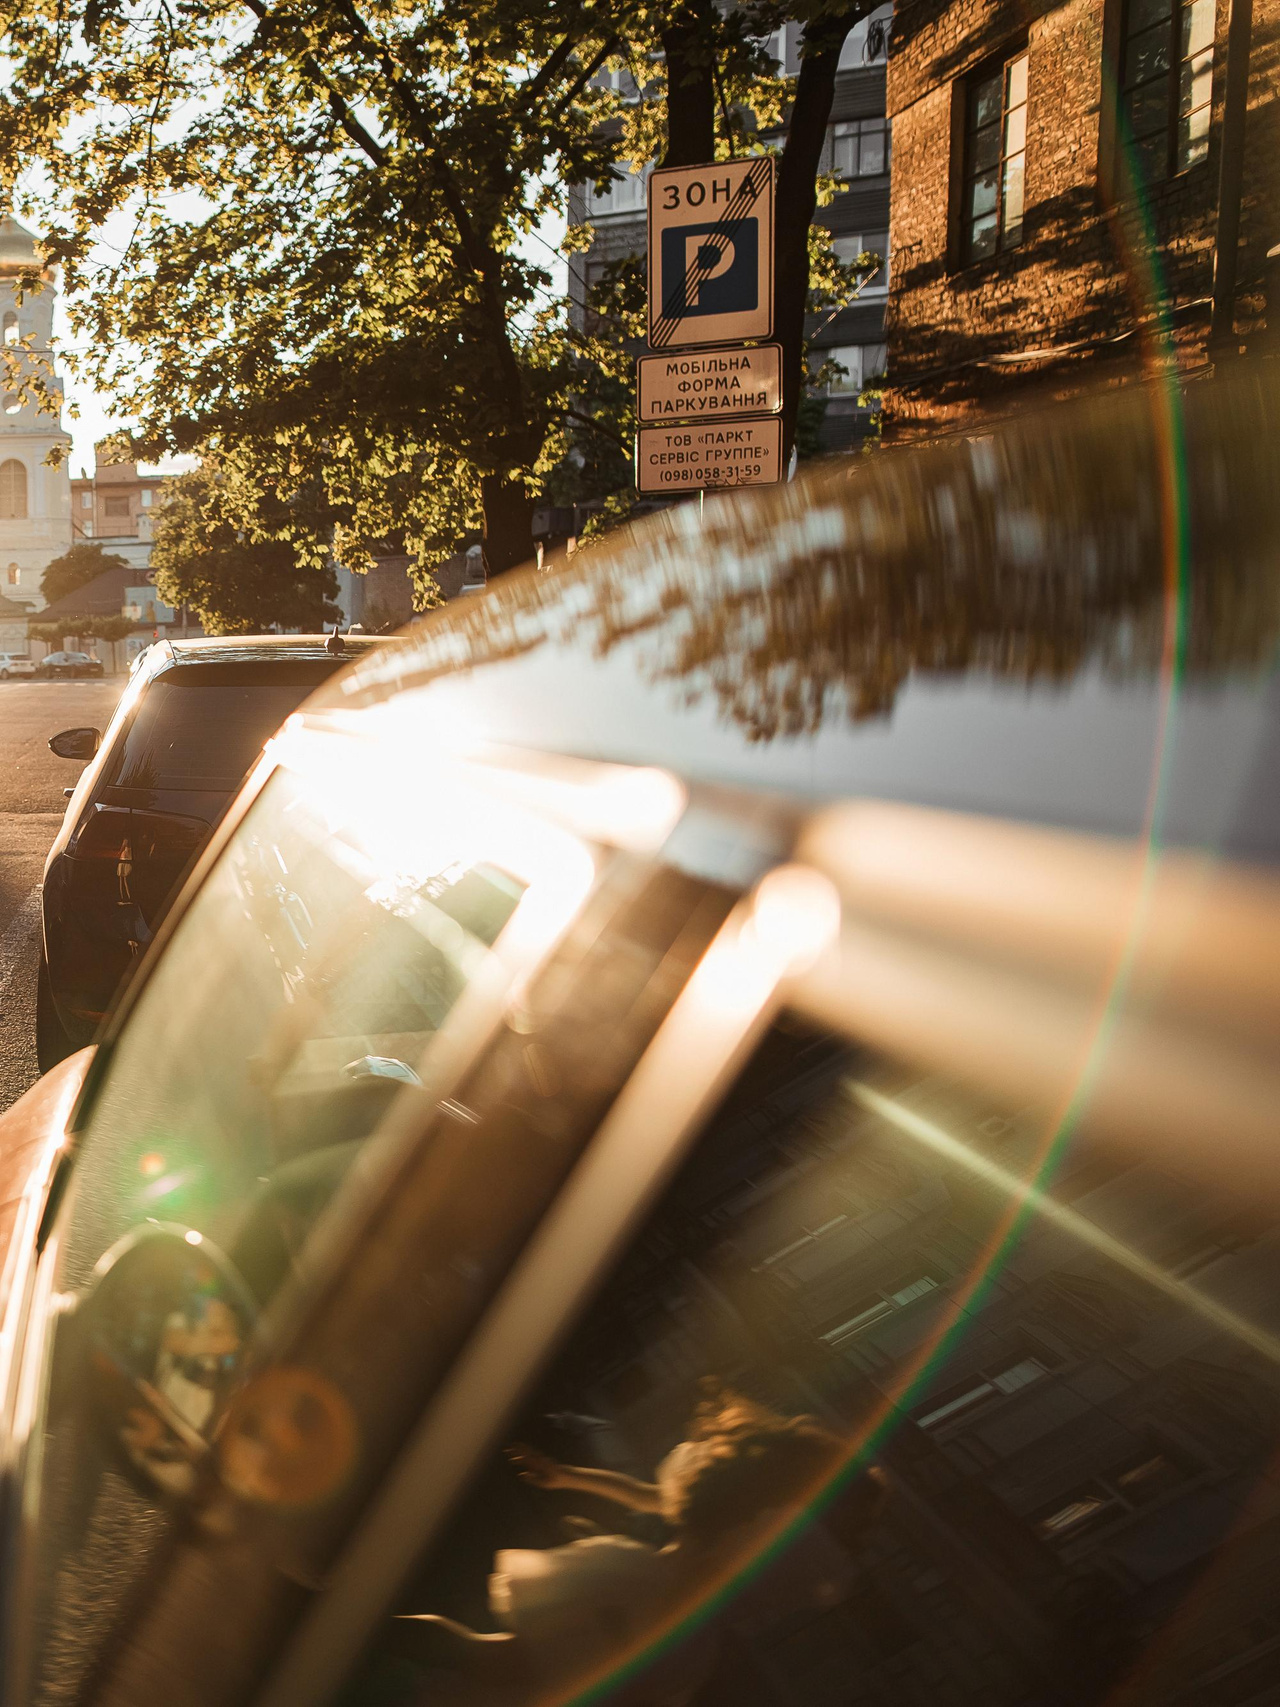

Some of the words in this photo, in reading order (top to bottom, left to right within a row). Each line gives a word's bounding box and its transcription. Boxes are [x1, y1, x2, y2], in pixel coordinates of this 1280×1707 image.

[662, 175, 758, 211] ЗОНА
[666, 356, 751, 376] МОБІЛЬНА
[678, 376, 741, 393] ФОРМА
[651, 392, 767, 414] ПАРКУВАННЯ
[665, 434, 692, 447] ТОВ
[649, 451, 700, 466] СЕРВІС
[706, 446, 769, 461] ГРУППЕ»
